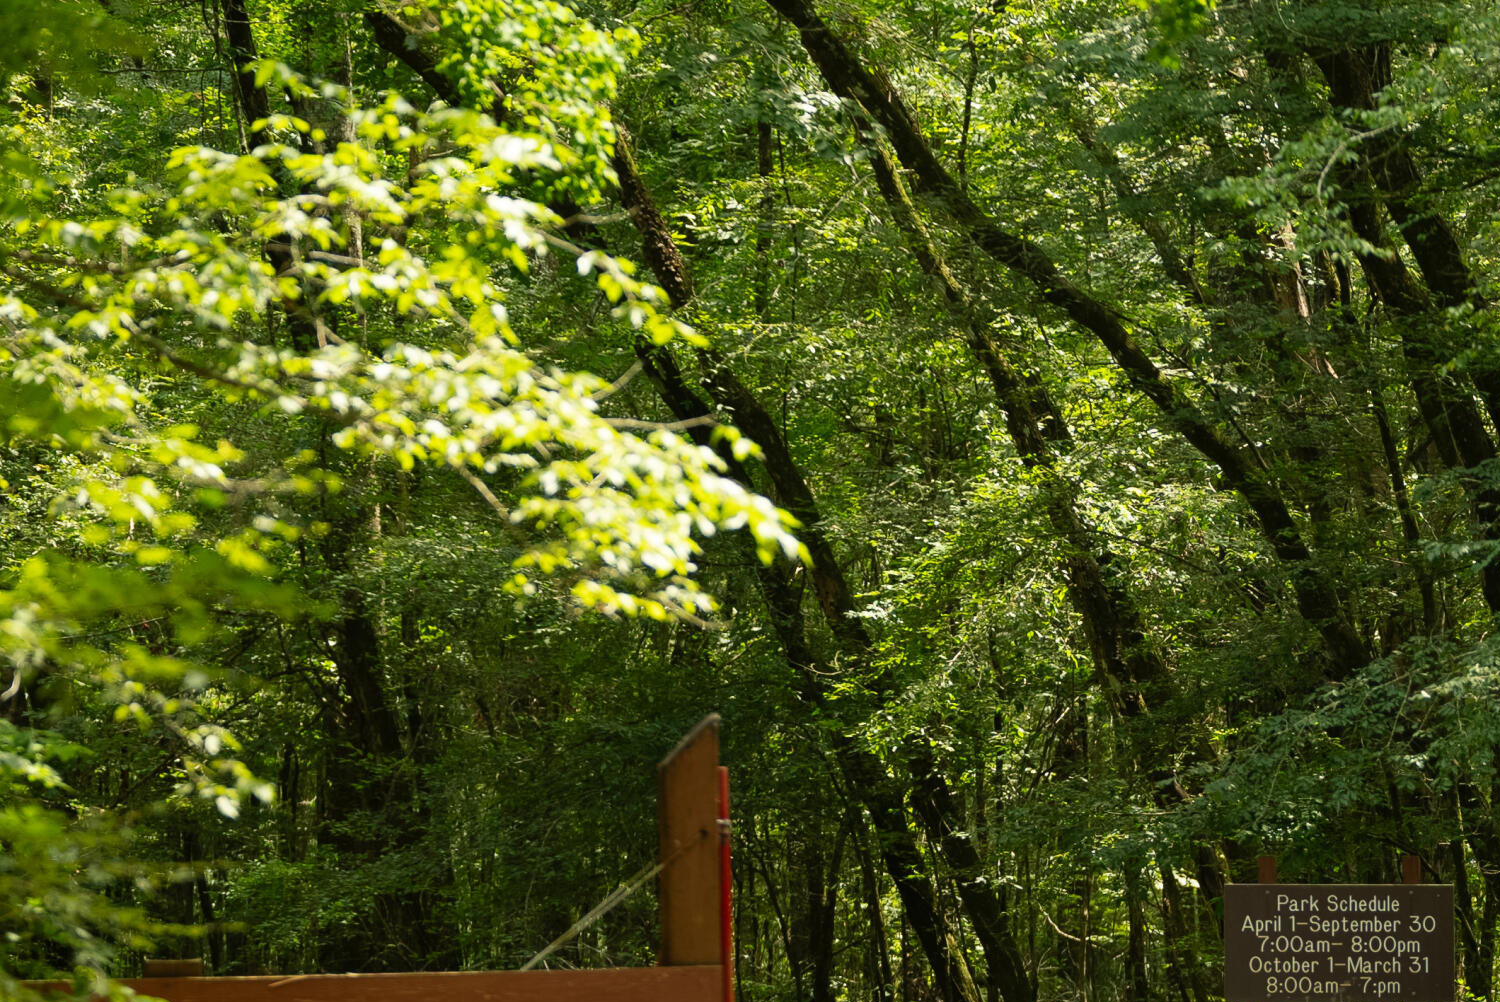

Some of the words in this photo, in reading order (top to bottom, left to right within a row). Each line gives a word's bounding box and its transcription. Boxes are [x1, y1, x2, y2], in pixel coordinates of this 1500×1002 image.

[1277, 894, 1319, 912] Park
[1327, 894, 1400, 912] Schedule
[1241, 915, 1281, 936] April
[1408, 915, 1436, 933] 30
[1351, 935, 1420, 957] 8:00pm
[1249, 956, 1319, 973] October
[1408, 956, 1430, 973] 31
[1359, 976, 1400, 998] 7:pm
